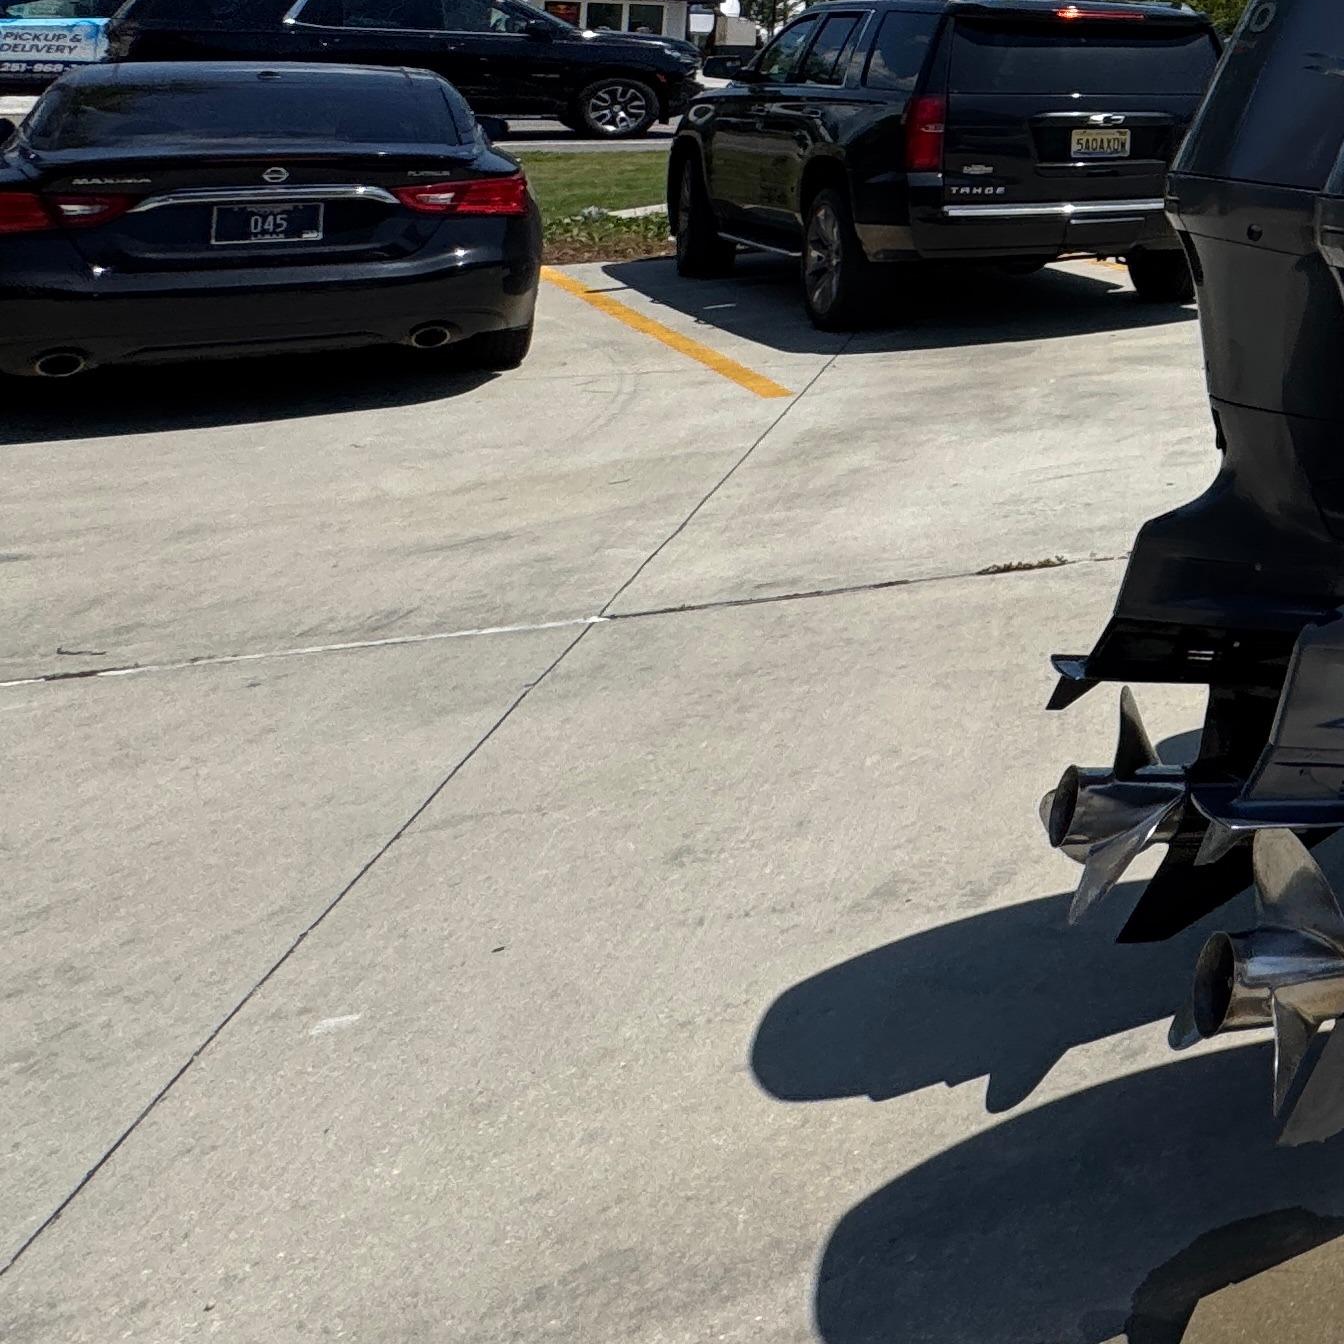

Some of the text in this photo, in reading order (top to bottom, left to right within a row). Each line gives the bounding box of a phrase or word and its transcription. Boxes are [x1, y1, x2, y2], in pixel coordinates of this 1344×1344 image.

[3, 31, 83, 43] PICKUP &
[0, 42, 78, 55] DELIVERY
[950, 186, 1007, 195] TAHOE
